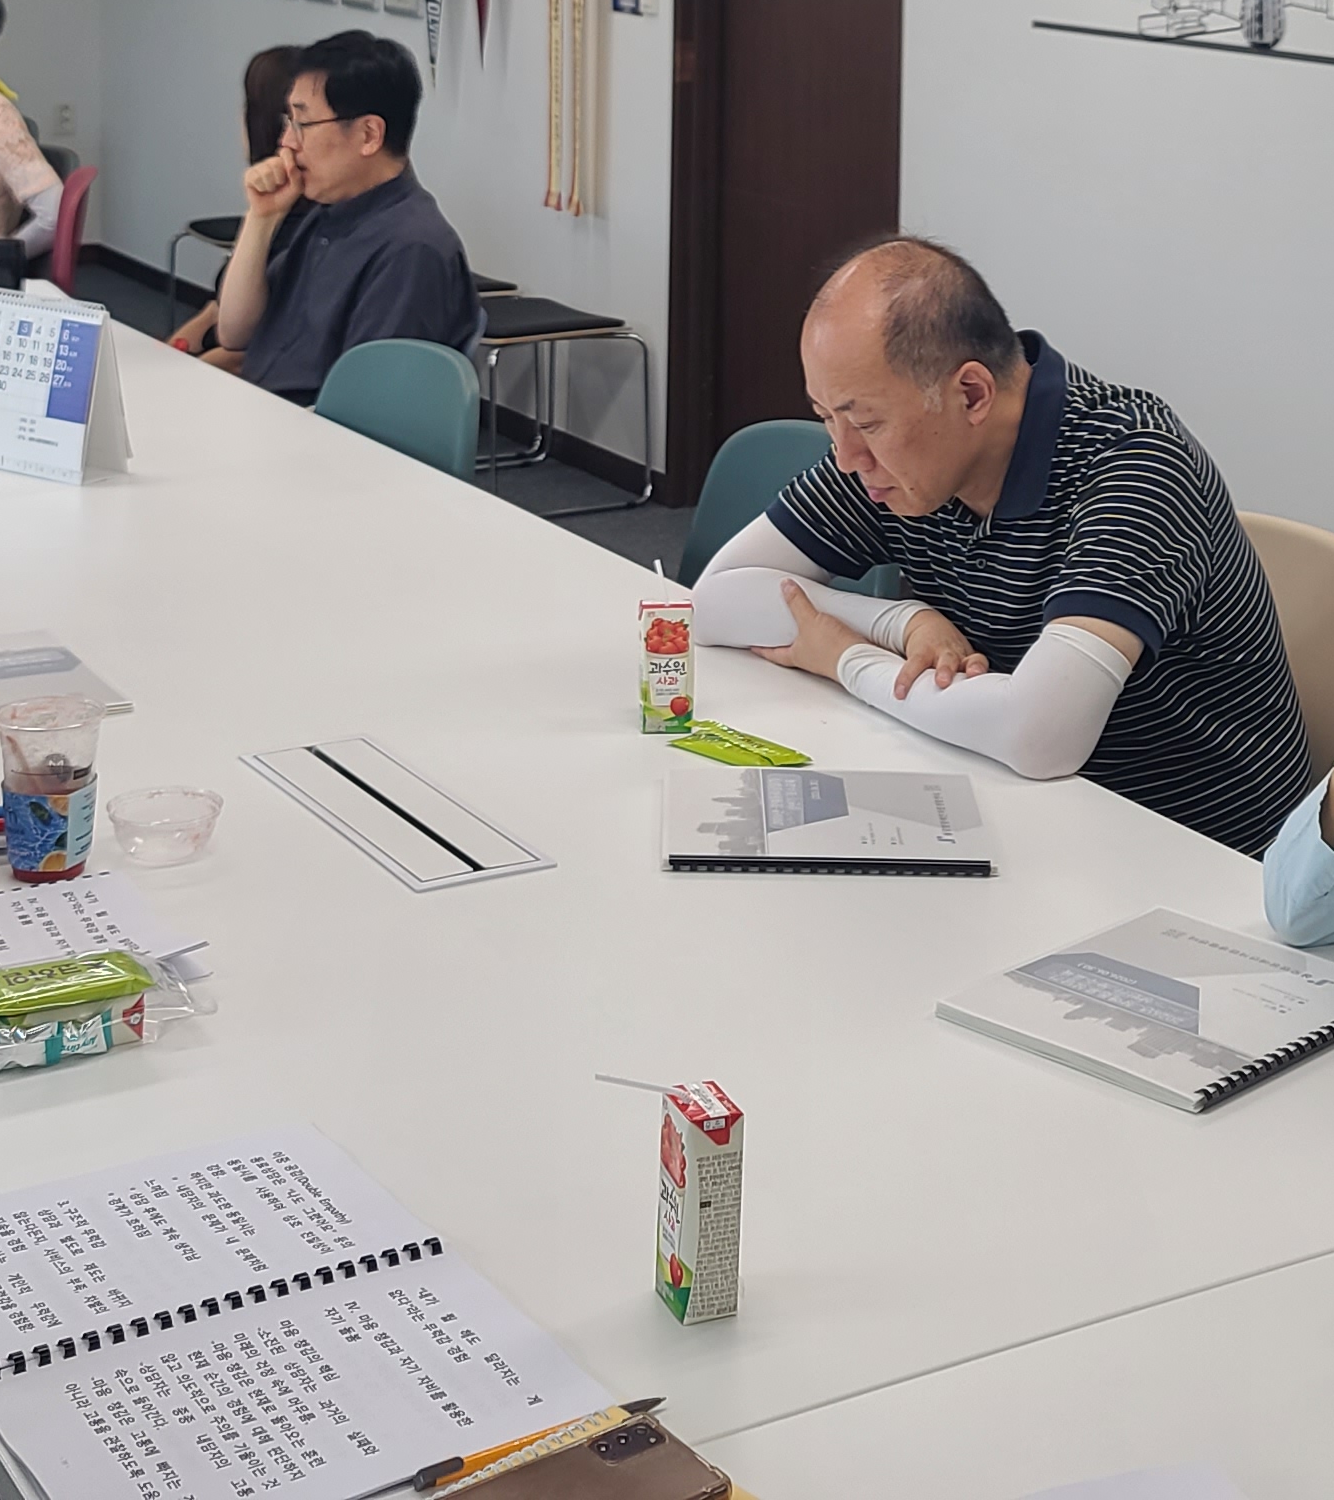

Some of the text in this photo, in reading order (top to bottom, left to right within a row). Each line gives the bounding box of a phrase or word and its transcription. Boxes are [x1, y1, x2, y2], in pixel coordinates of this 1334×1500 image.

[2, 350, 11, 361] 16
[16, 352, 25, 363] 17
[29, 354, 39, 366] 18
[43, 357, 52, 368] 19
[55, 359, 67, 372] 20
[9, 321, 15, 331] 2
[21, 323, 28, 333] 3
[35, 325, 42, 336] 4
[49, 327, 56, 338] 5
[63, 330, 69, 340] 6
[11, 367, 23, 378] 24
[25, 369, 37, 381] 25
[38, 372, 50, 384] 26
[52, 374, 64, 387] 27
[648, 658, 687, 676] 과수원
[656, 676, 679, 686] 사과
[190, 1172, 255, 1236] 하지만 과도한 동일시는
[273, 1152, 291, 1164] 이중
[319, 1198, 352, 1224] Empathy)
[57, 1200, 107, 1248] 3. 구조적 무력감
[129, 1193, 201, 1261] 상담 후에도 계속 생각남
[176, 1184, 269, 1272] 내담자의 문제가 내 문제처럼
[13, 1212, 110, 1314] 않는다든지, 서비스의 부족, 차별의
[9, 1311, 35, 1334] 경험함.
[279, 1320, 340, 1382] 마음 챙김의 핵심
[324, 1307, 362, 1342] 자기 돌봄
[423, 1323, 453, 1345] 무력감
[447, 1345, 471, 1363] 경험
[234, 1332, 316, 1425] 미래의 걱정 속에 머무름.
[359, 1314, 379, 1330] 마음
[374, 1332, 404, 1355] 챙김과
[399, 1356, 422, 1374] 자기
[417, 1375, 447, 1400] 자비를
[441, 1402, 474, 1427] 활용한
[460, 1329, 481, 1346] 해도
[484, 1353, 520, 1386] 달라지는
[527, 1394, 543, 1406] 게
[226, 1362, 255, 1387] 챙김은
[247, 1388, 277, 1414] 현재로
[270, 1415, 305, 1448] 돌아오는
[301, 1450, 327, 1468] 훈련
[284, 1362, 317, 1393] 상담자는
[318, 1399, 350, 1425] 과거의
[347, 1431, 379, 1456] 실패와
